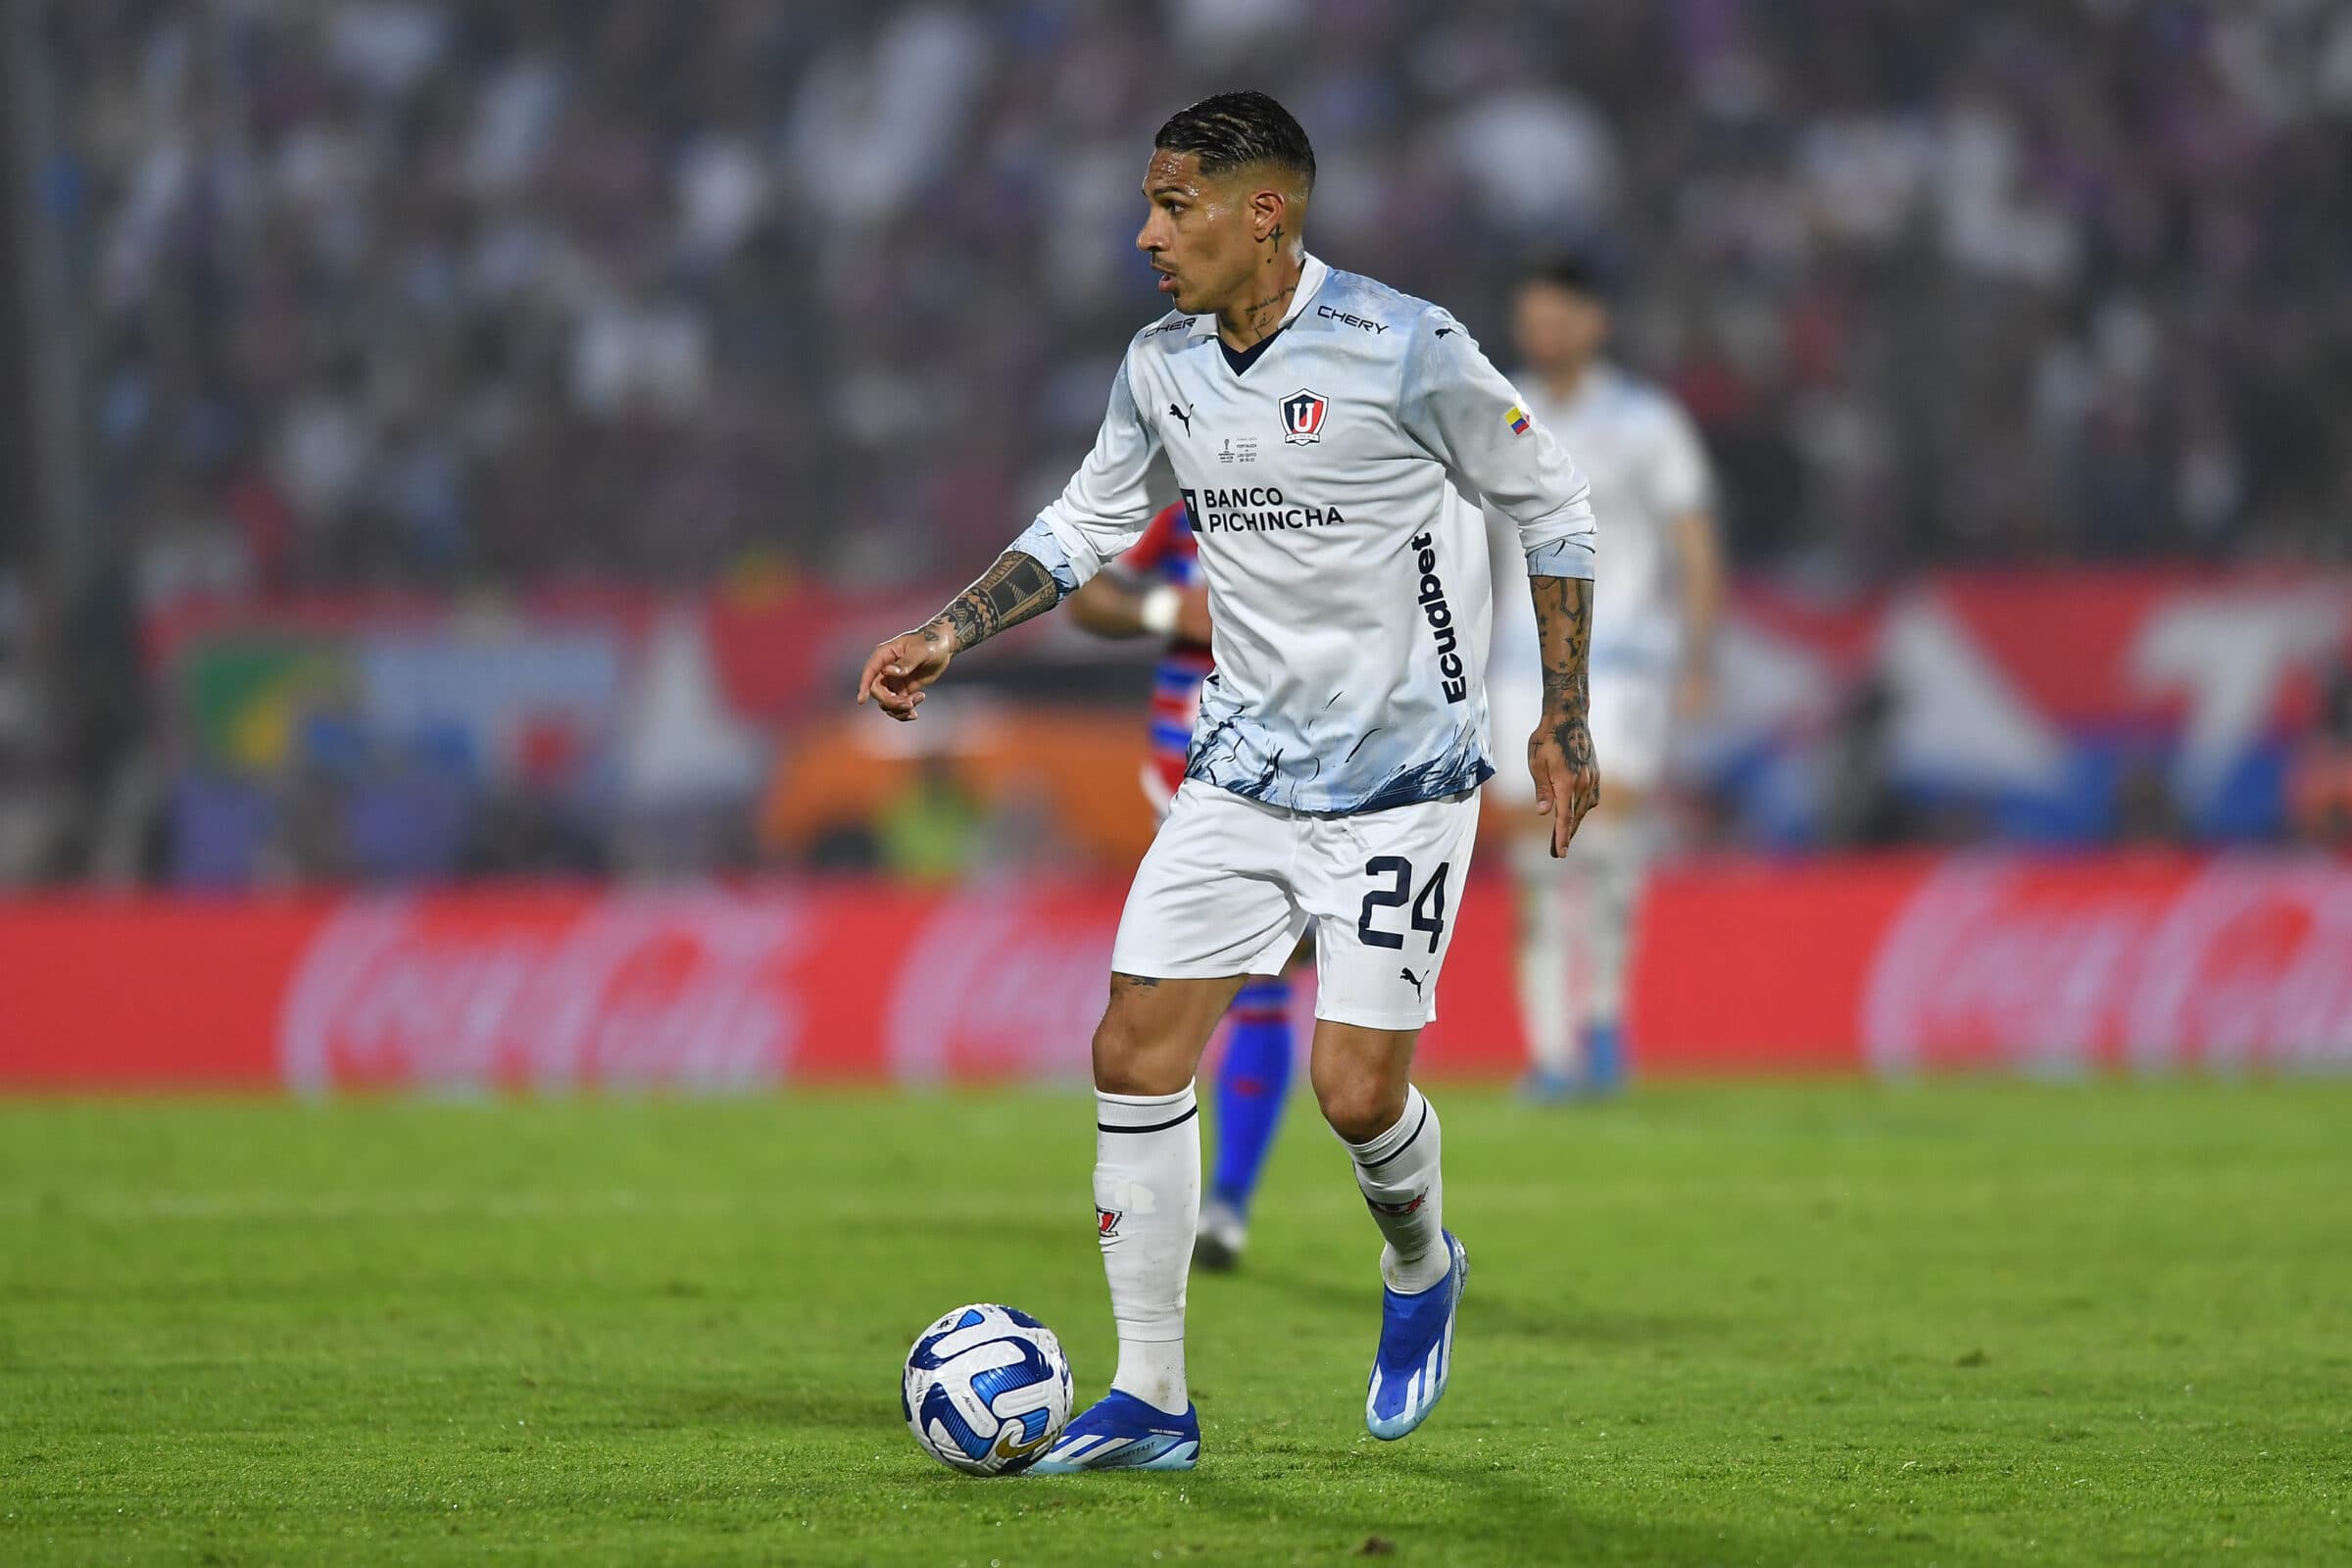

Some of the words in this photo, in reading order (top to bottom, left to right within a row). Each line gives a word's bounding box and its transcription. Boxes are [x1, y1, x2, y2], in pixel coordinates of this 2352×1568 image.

[1144, 317, 1197, 338] CHER
[1317, 305, 1391, 335] CHERY
[1293, 403, 1315, 433] U
[1203, 487, 1284, 509] BANCO
[1208, 506, 1346, 533] PICHINCHA
[1411, 531, 1467, 705] Ecuabet
[1357, 856, 1450, 955] 24
